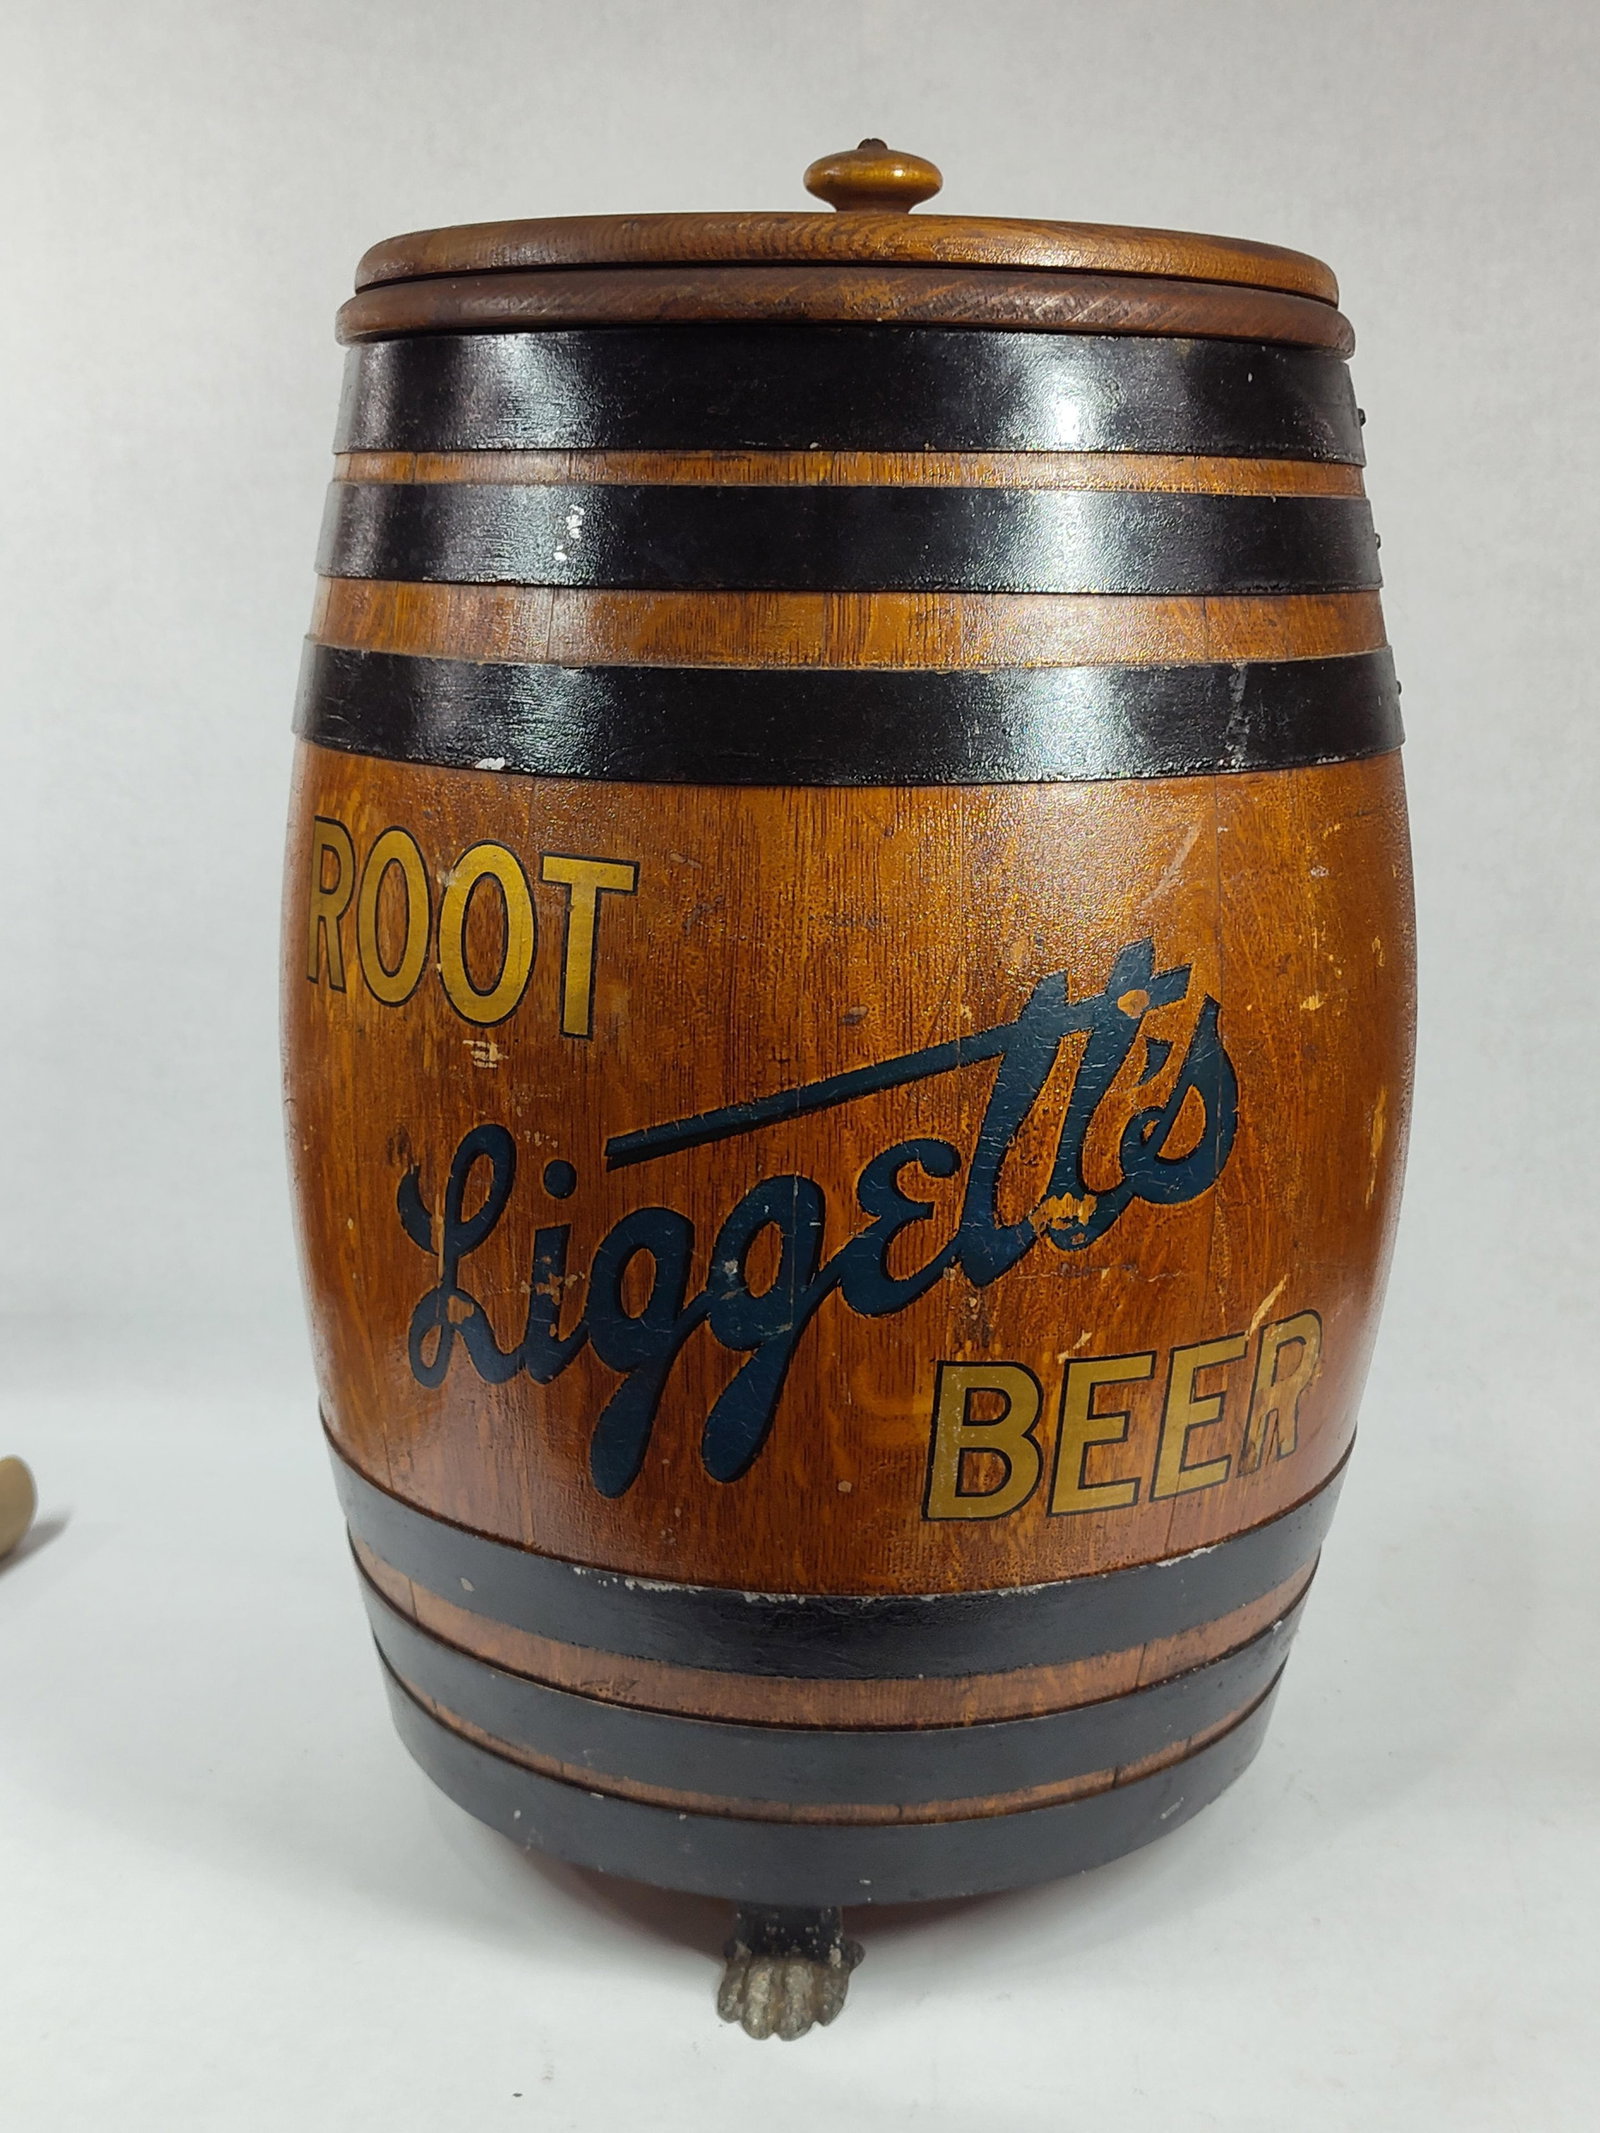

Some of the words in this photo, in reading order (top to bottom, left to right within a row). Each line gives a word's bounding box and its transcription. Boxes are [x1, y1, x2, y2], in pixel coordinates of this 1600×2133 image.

[306, 815, 640, 1040] ROOT
[399, 939, 1239, 1498] Liggett's
[923, 1310, 1322, 1522] BEER
